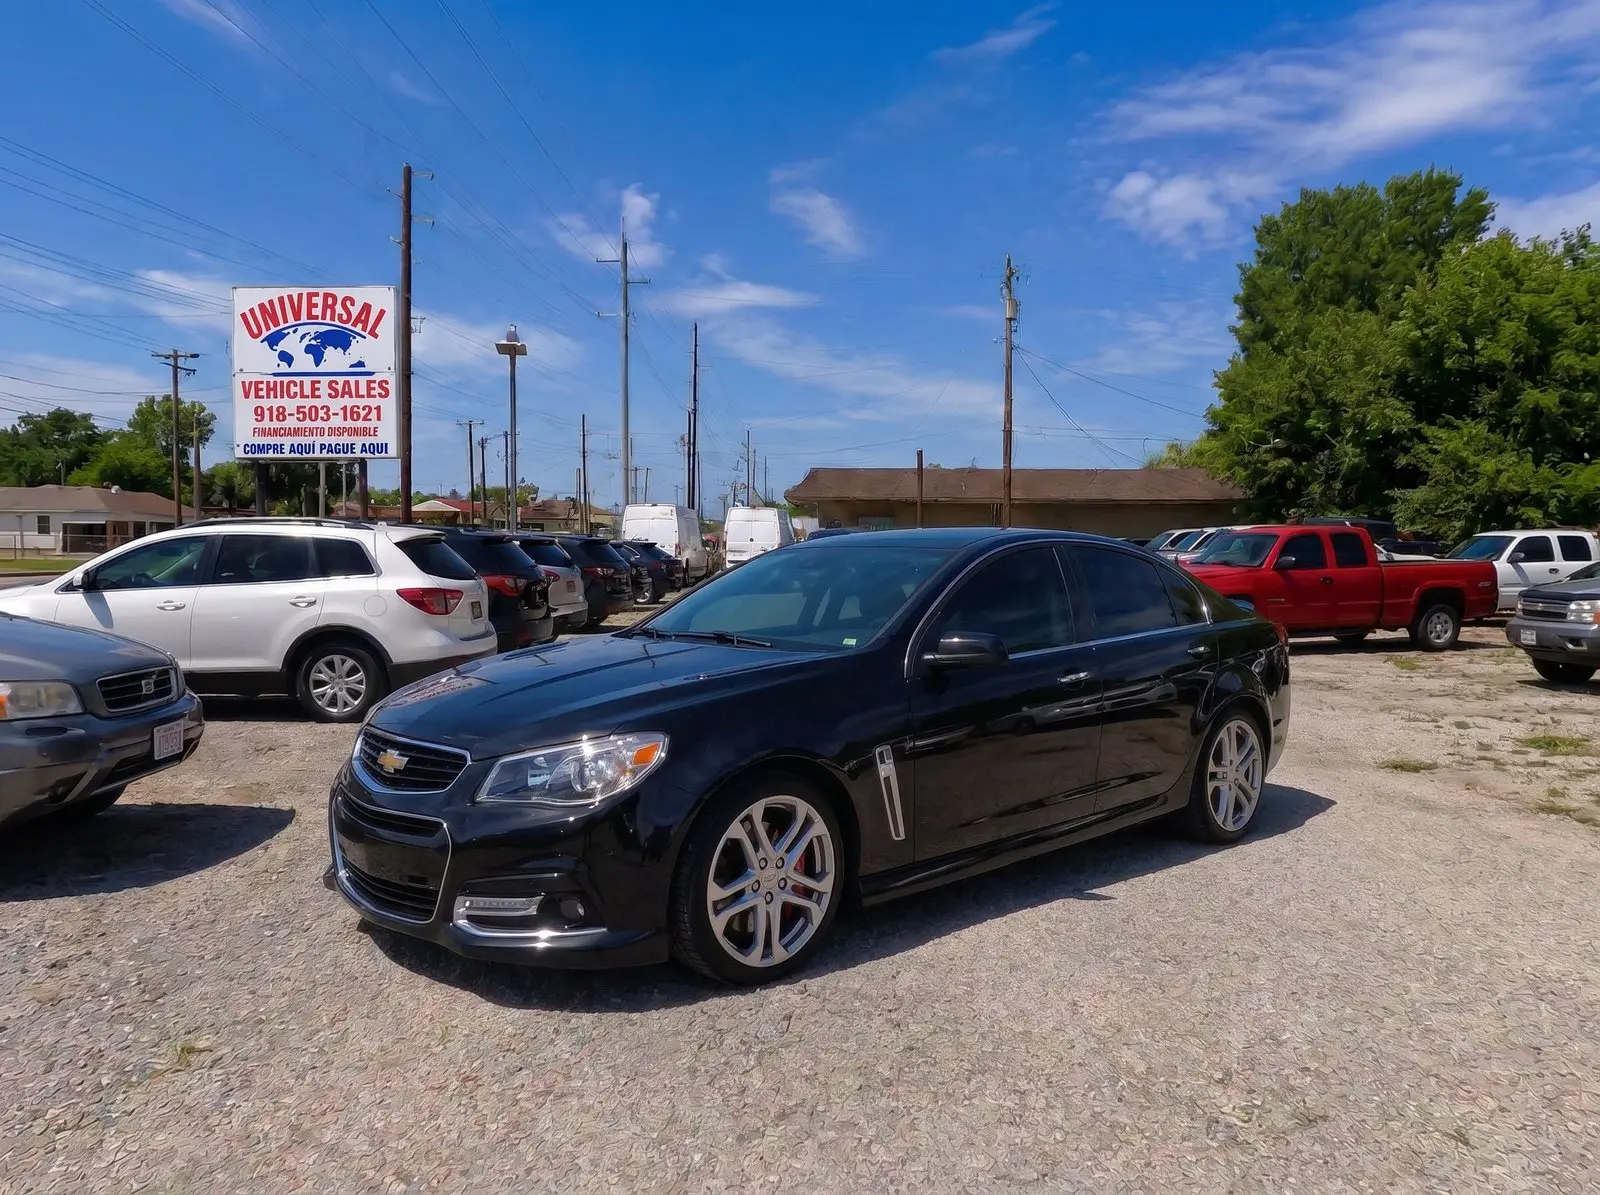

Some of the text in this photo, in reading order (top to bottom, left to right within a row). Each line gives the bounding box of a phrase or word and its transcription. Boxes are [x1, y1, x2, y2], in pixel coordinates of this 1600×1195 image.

[240, 292, 386, 340] UNIVERSAL
[241, 379, 390, 399] VEHICLE SALES
[254, 404, 382, 422] 918-503-1621
[252, 426, 379, 437] FINANCIAMIENTO DISPONIBLE
[243, 440, 389, 456] COMPRE AQUÍ PAGUE AQUI
